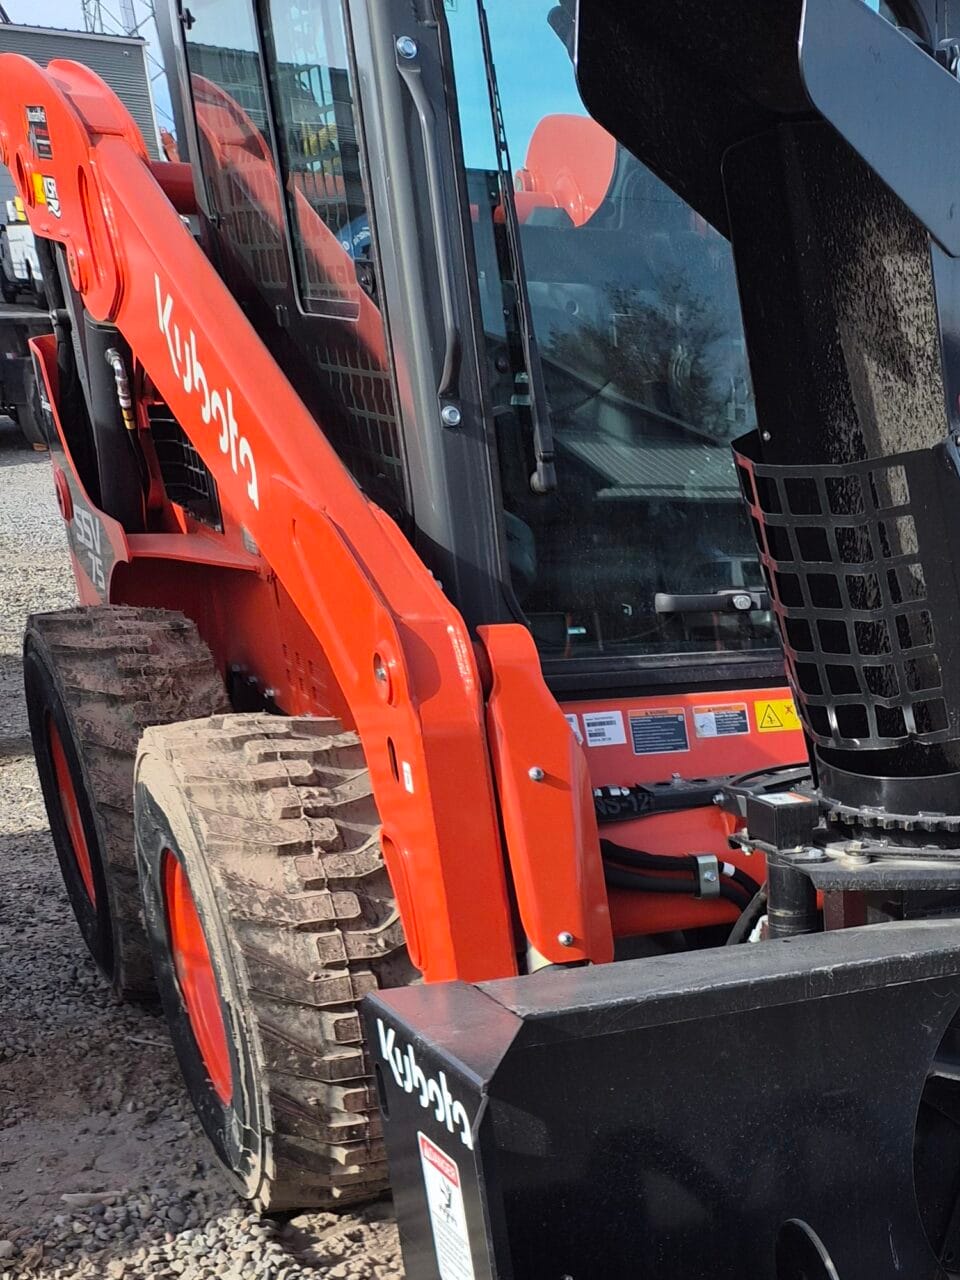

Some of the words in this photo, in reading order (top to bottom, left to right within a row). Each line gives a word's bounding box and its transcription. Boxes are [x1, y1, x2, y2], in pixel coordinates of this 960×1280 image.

[154, 273, 260, 511] Kubota
[73, 504, 102, 556] SSV
[87, 551, 106, 591] 75
[376, 1017, 474, 1151] Kubota
